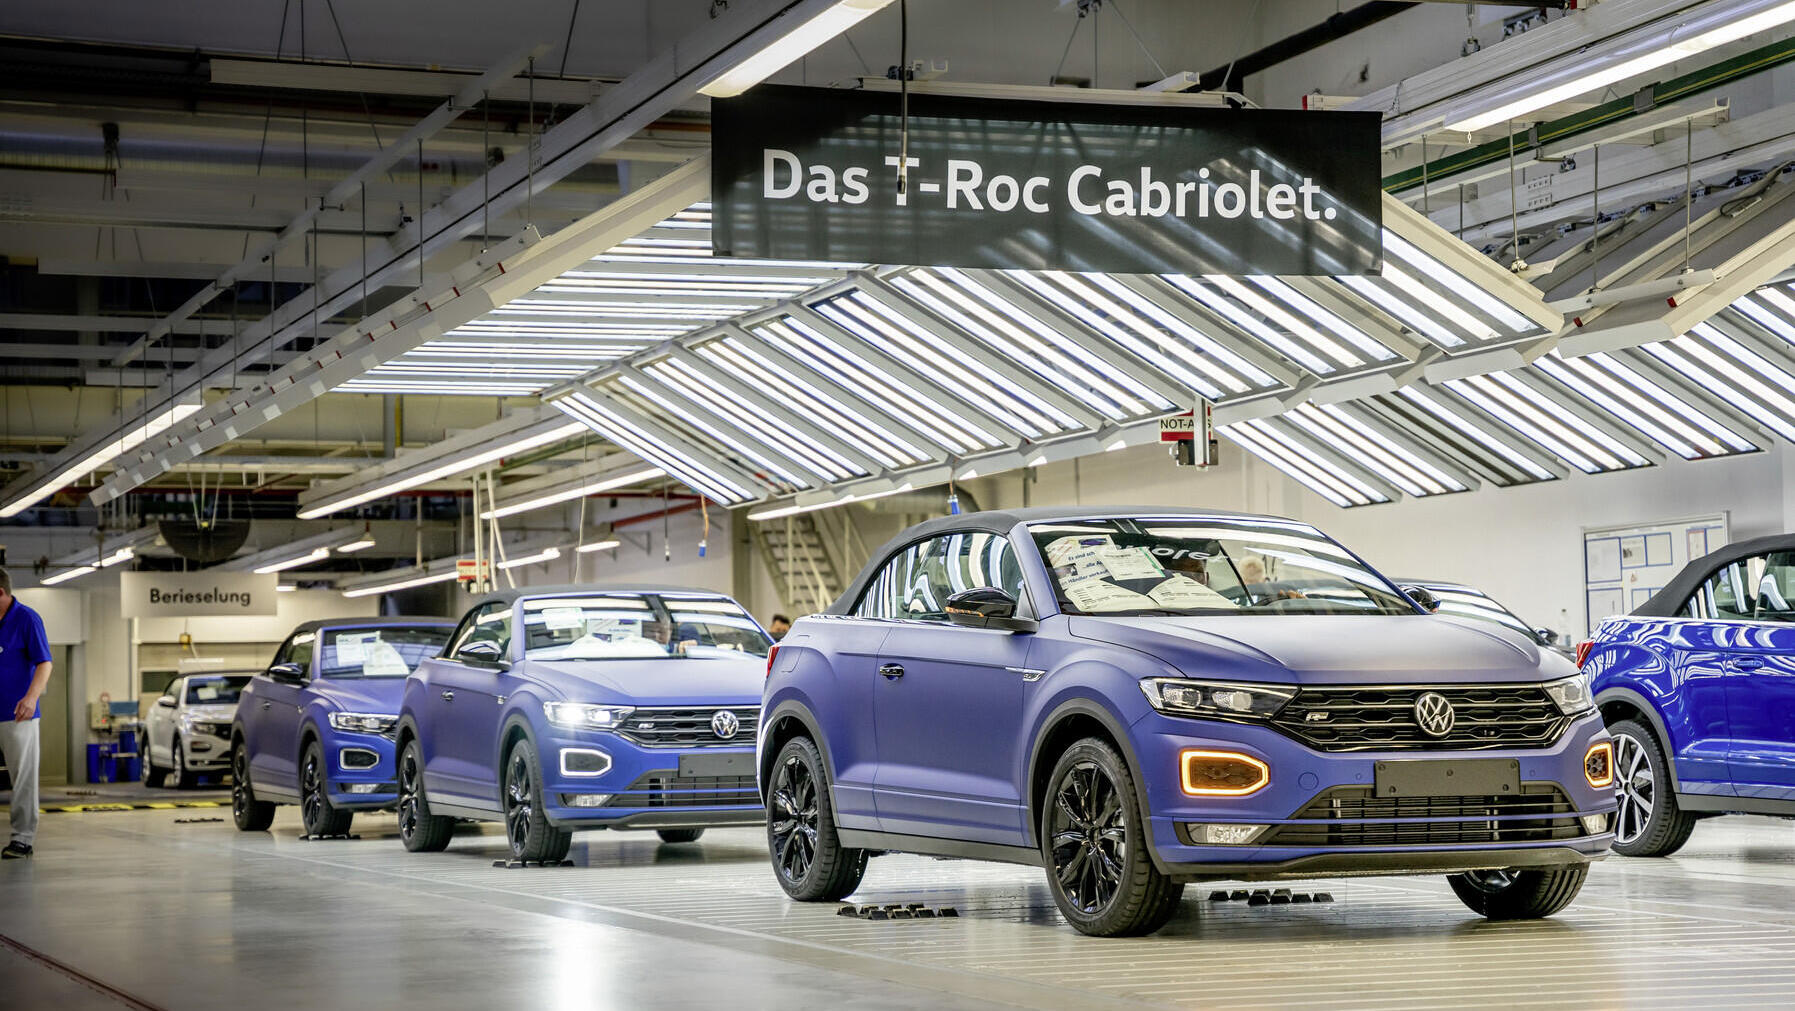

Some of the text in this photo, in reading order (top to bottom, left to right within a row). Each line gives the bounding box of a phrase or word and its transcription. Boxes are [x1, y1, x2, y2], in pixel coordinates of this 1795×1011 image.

[763, 148, 1338, 221] Das T-Roc Cabriolet.
[1160, 418, 1212, 429] NOT-A
[150, 587, 251, 607] Berieselung
